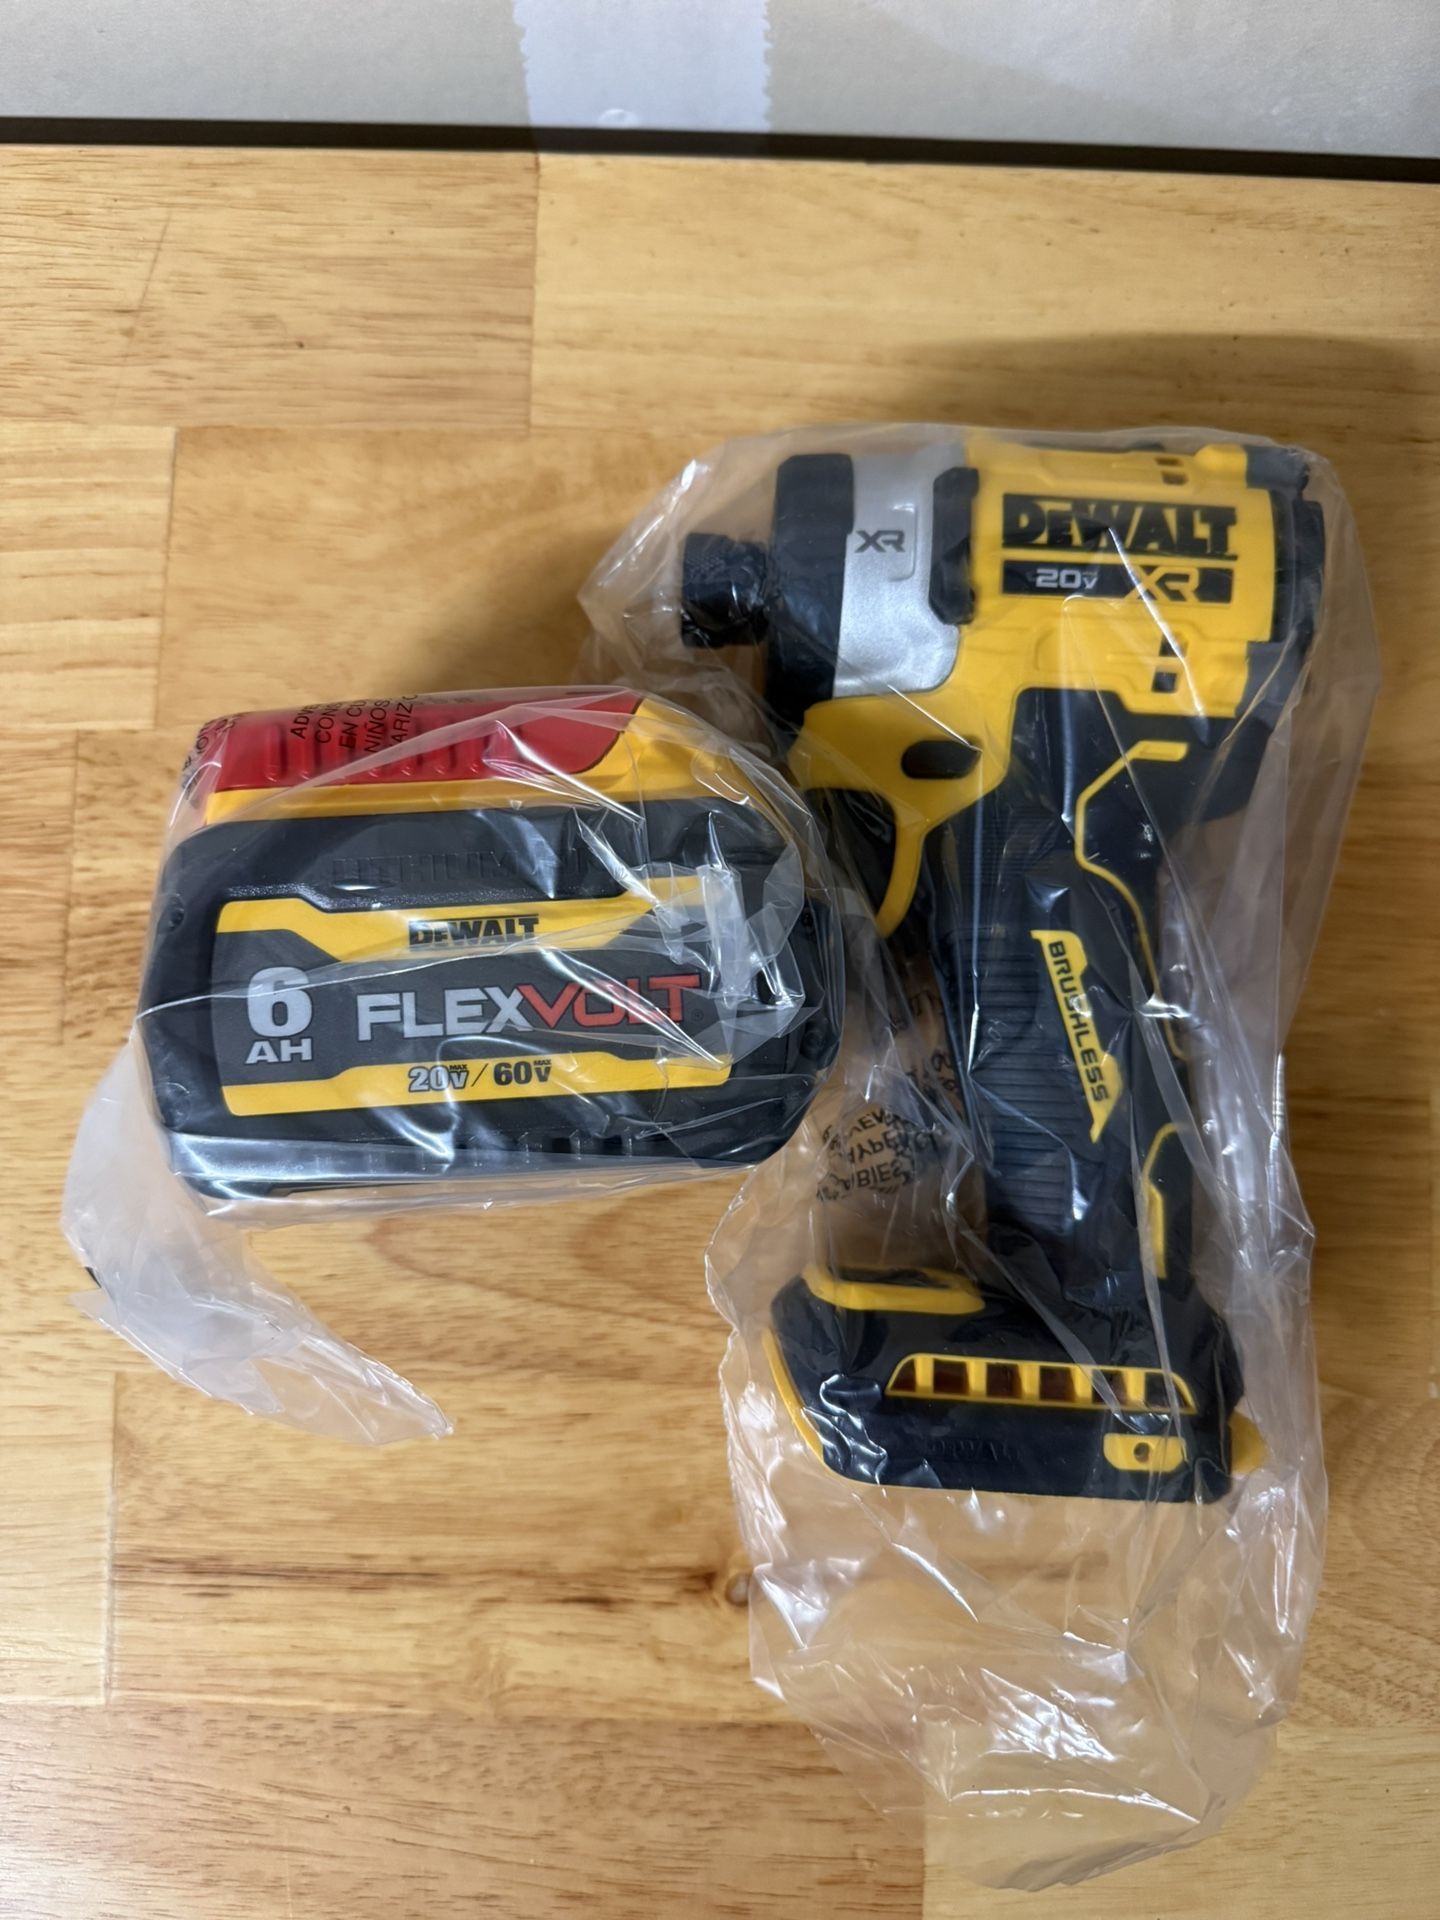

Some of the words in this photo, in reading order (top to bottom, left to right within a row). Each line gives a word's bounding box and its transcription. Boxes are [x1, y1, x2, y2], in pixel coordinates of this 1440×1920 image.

[854, 529, 906, 553] XR
[1002, 493, 1238, 560] DEWALT
[1123, 566, 1200, 602] XR
[409, 914, 540, 950] DEWALT
[248, 966, 312, 1037] 6
[357, 973, 701, 1041] FLEXVOLT
[1048, 941, 1110, 1102] BRUSHLESS
[245, 1038, 313, 1064] AH
